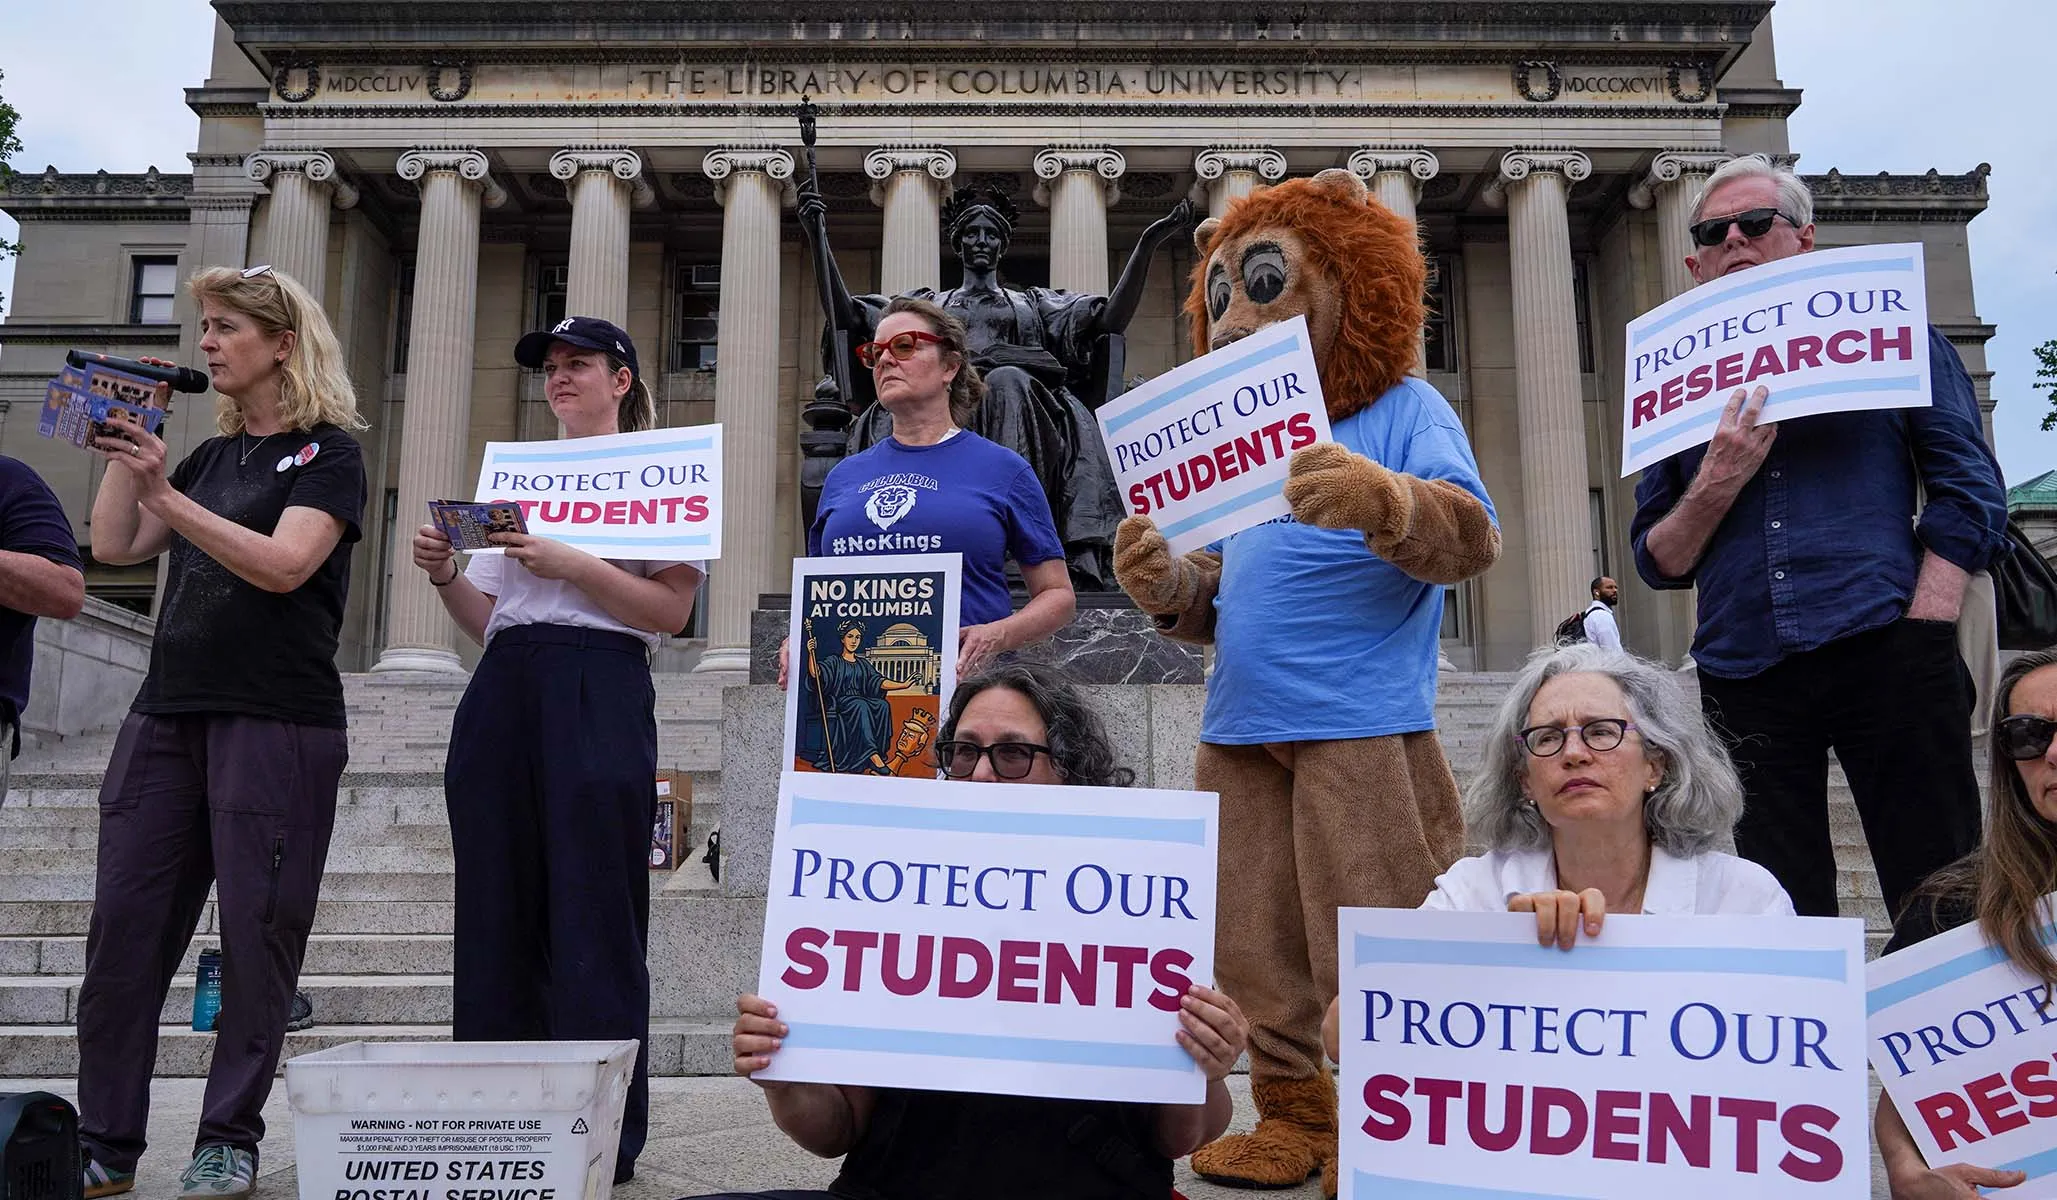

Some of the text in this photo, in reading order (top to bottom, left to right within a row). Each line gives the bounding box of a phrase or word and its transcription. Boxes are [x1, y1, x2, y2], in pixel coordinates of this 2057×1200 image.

[327, 76, 420, 92] MDCCLIV
[640, 70, 1349, 95] THE LIBRARY OF COLUMBIA UNIVERSITY
[1563, 77, 1665, 93] MDCCCXCVII
[1633, 289, 1911, 384] PROTECT OUR
[1632, 326, 1913, 430] RESEARCH
[1114, 371, 1307, 474] PROTECT OUR
[490, 463, 710, 492] PROTECT OUR
[1128, 412, 1317, 516] STUDENTS
[858, 473, 938, 493] COLUMBIA
[490, 496, 710, 525] TUDENTS
[832, 533, 942, 555] #NoKings
[811, 577, 934, 601] NO KINGS
[811, 601, 933, 617] AT COLUMBIA
[788, 848, 1199, 921] PROTECT OUR
[781, 927, 1195, 1013] STUDENTS
[1359, 989, 1843, 1072] PROTECT OUR
[1877, 985, 2057, 1077] PROTE
[1915, 1052, 2057, 1153] RES
[351, 1120, 406, 1130] WARNING
[415, 1120, 439, 1130] NOT
[442, 1120, 466, 1130] FOR
[468, 1120, 515, 1130] PRIVATE
[518, 1120, 542, 1130] USE
[1360, 1073, 1844, 1183] STUDENTS
[345, 1161, 545, 1180] UNITED STATES
